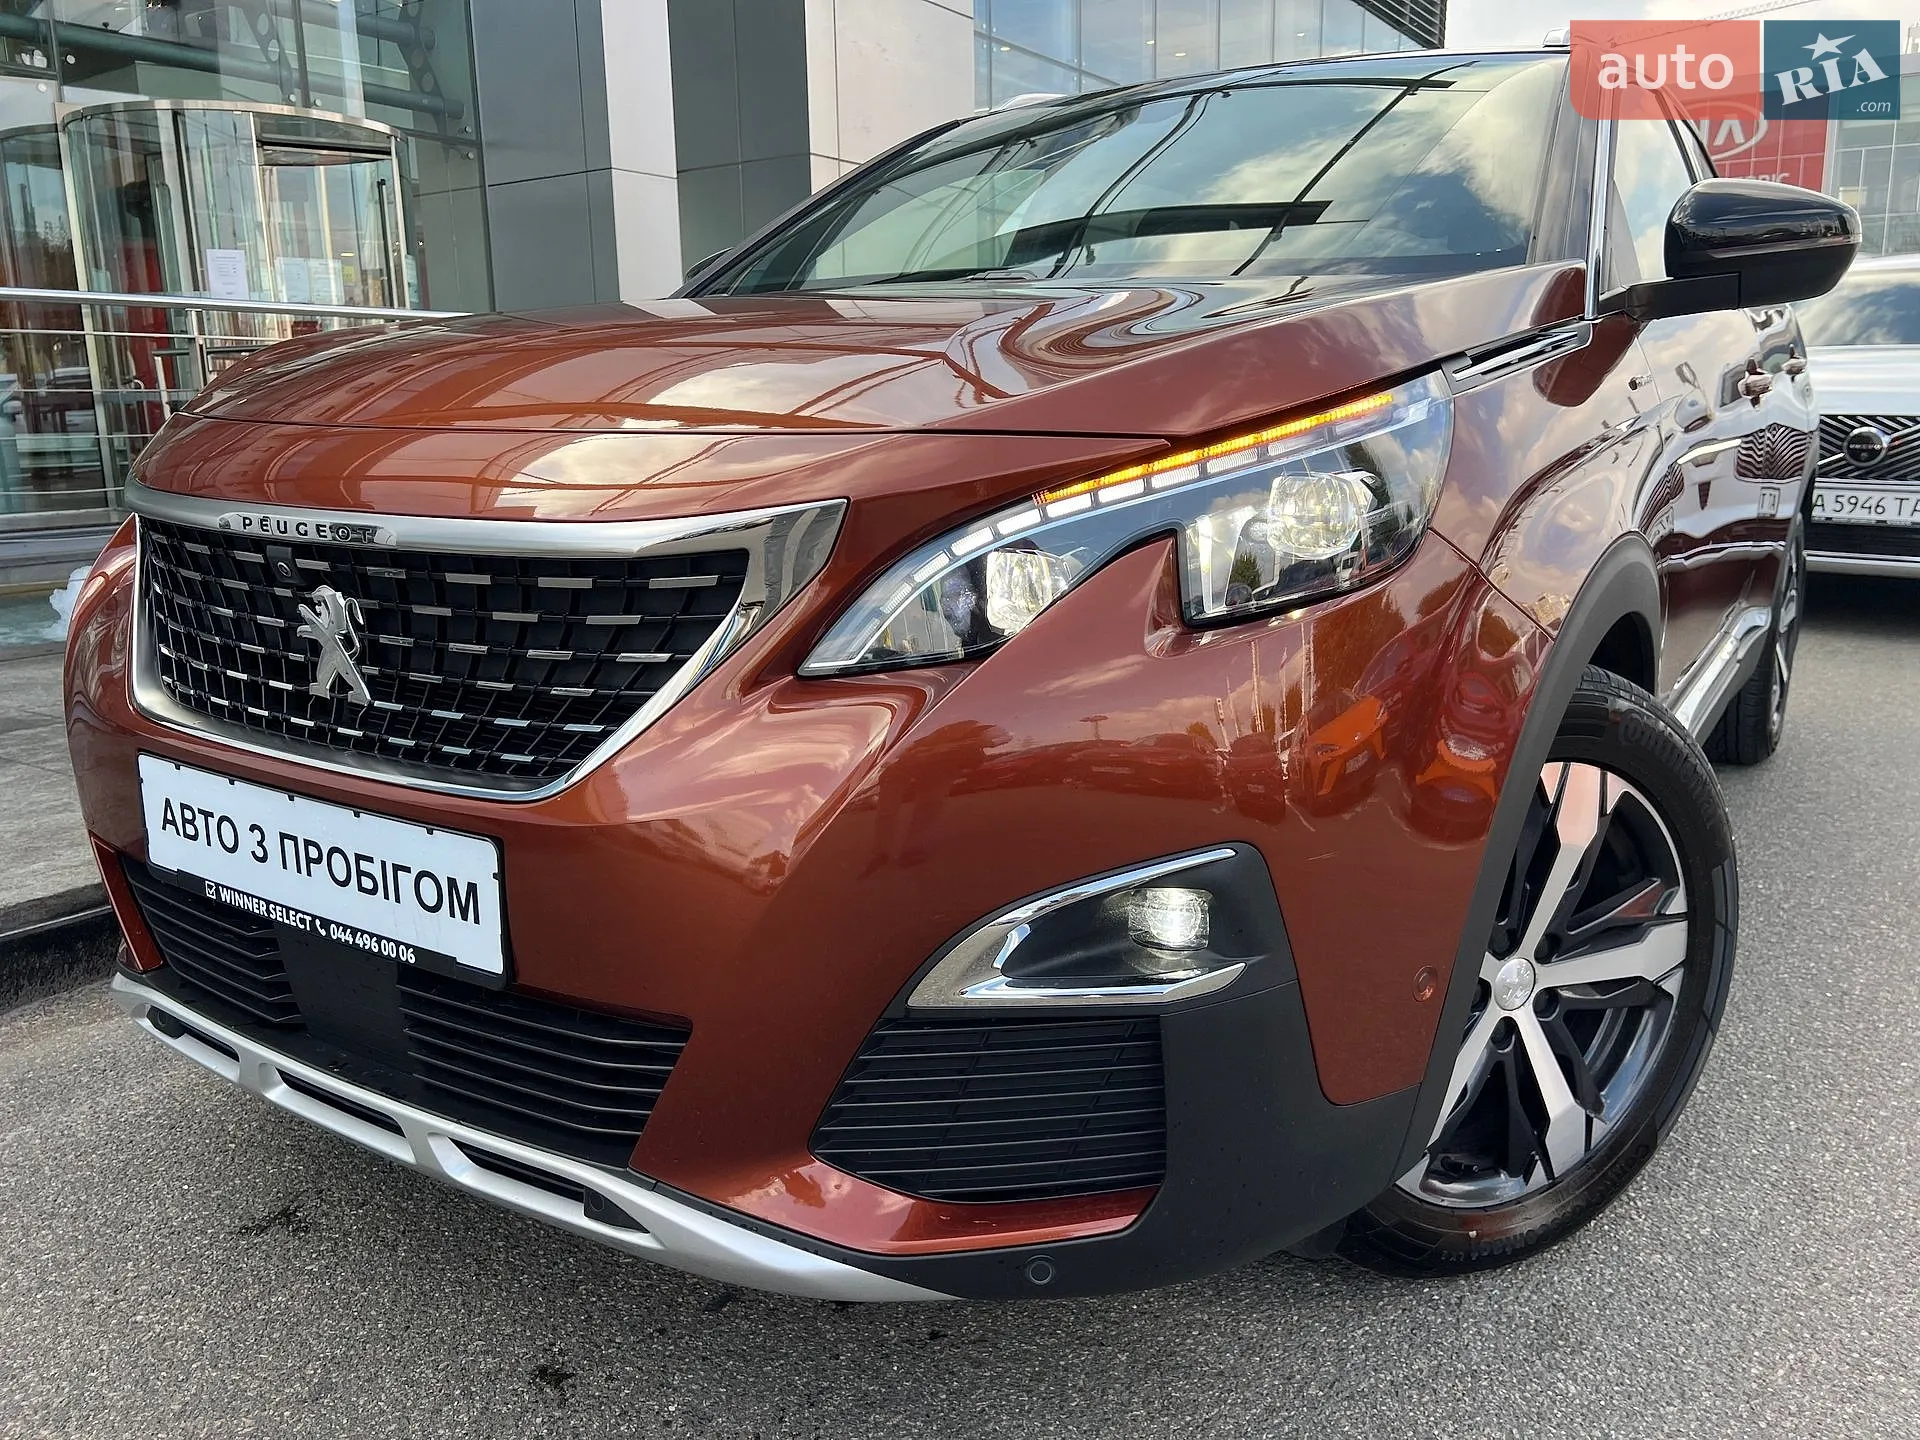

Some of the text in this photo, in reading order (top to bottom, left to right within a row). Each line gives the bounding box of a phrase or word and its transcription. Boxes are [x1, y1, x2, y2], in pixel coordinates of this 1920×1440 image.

[242, 516, 372, 544] PEUGEOT
[1812, 494, 1825, 512] A
[1833, 495, 1886, 515] 5946
[161, 797, 239, 854] АВТО
[279, 831, 481, 925] ПРОБІГОМ
[218, 886, 416, 964] WINNER SELECT 044 496 00 06
